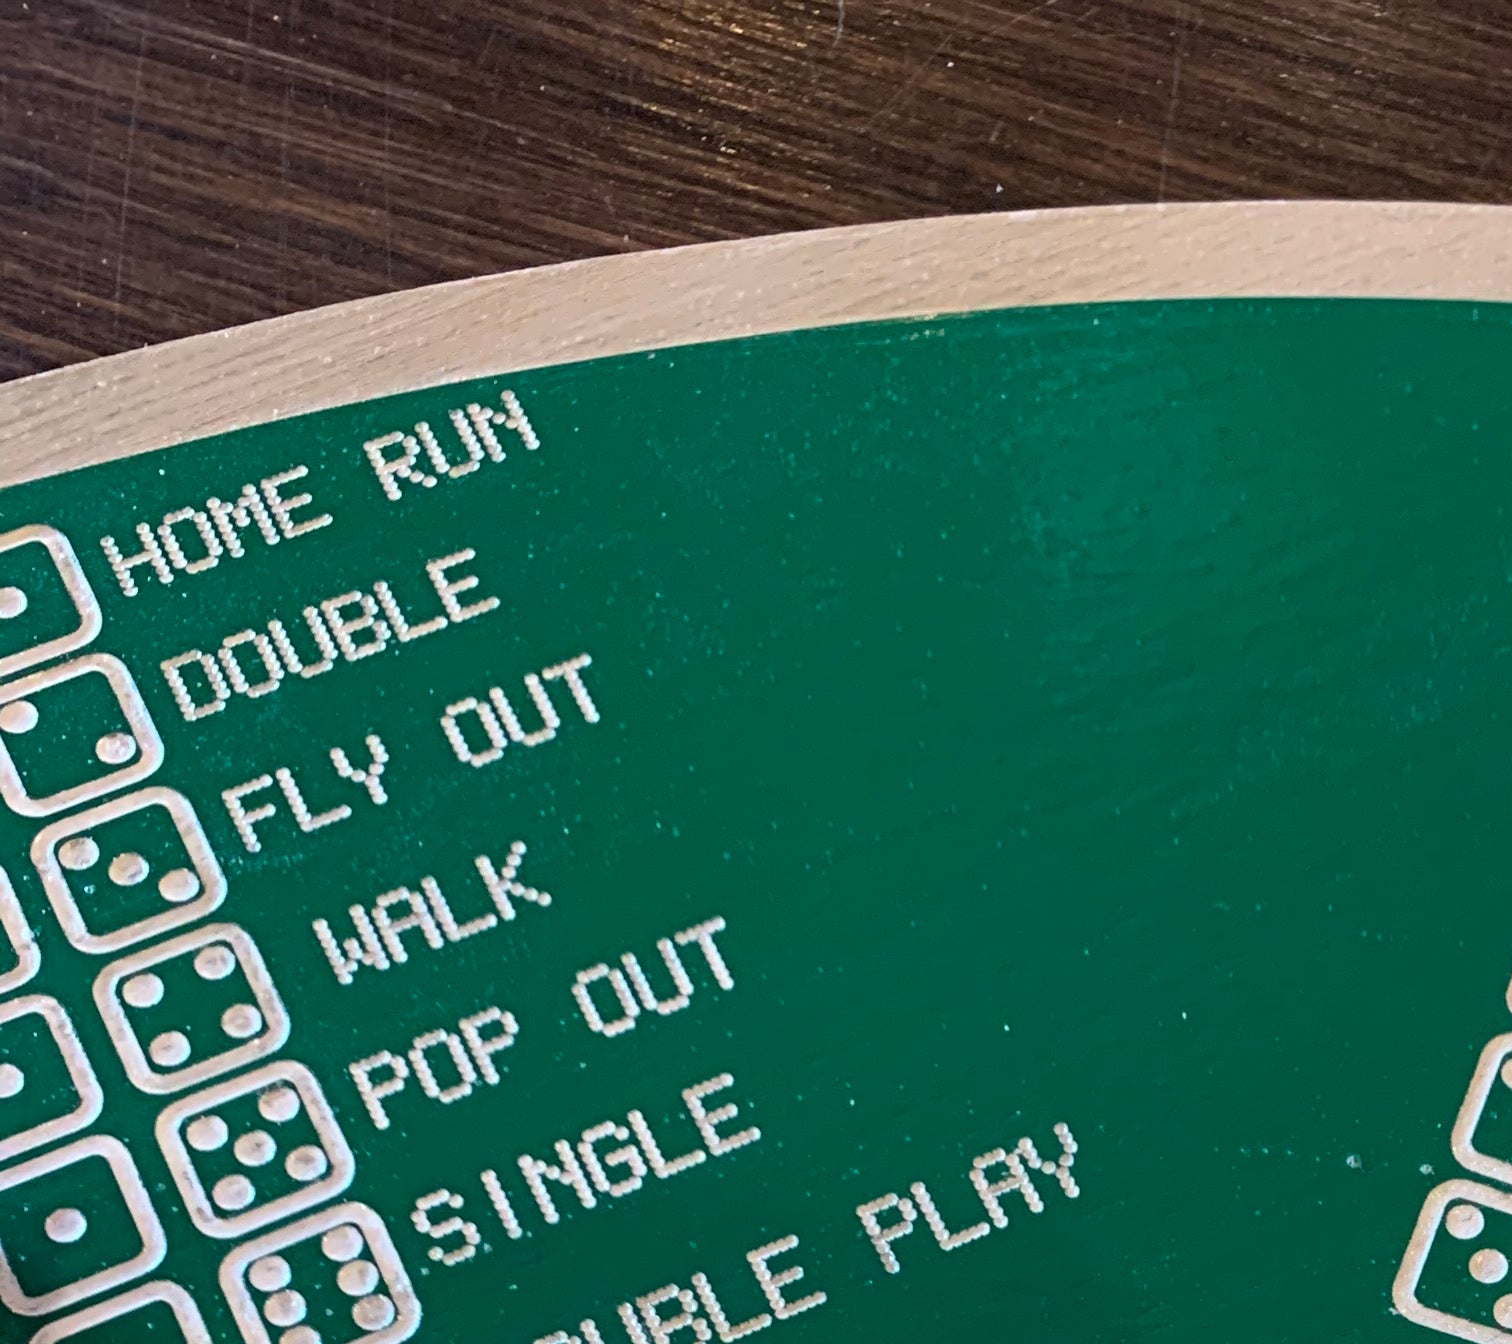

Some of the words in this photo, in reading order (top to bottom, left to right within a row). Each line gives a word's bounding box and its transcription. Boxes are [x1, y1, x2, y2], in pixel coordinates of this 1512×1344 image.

[100, 465, 332, 596] HOME
[363, 390, 538, 500] RUN
[160, 549, 498, 721] DOUBLE
[222, 735, 387, 852] FLY
[441, 654, 597, 767] OUT
[313, 842, 550, 984] WALK
[349, 1007, 518, 1129] POP
[572, 917, 732, 1037] OUT
[411, 1074, 759, 1265] SINGLE
[857, 1123, 1078, 1273] PLAY
